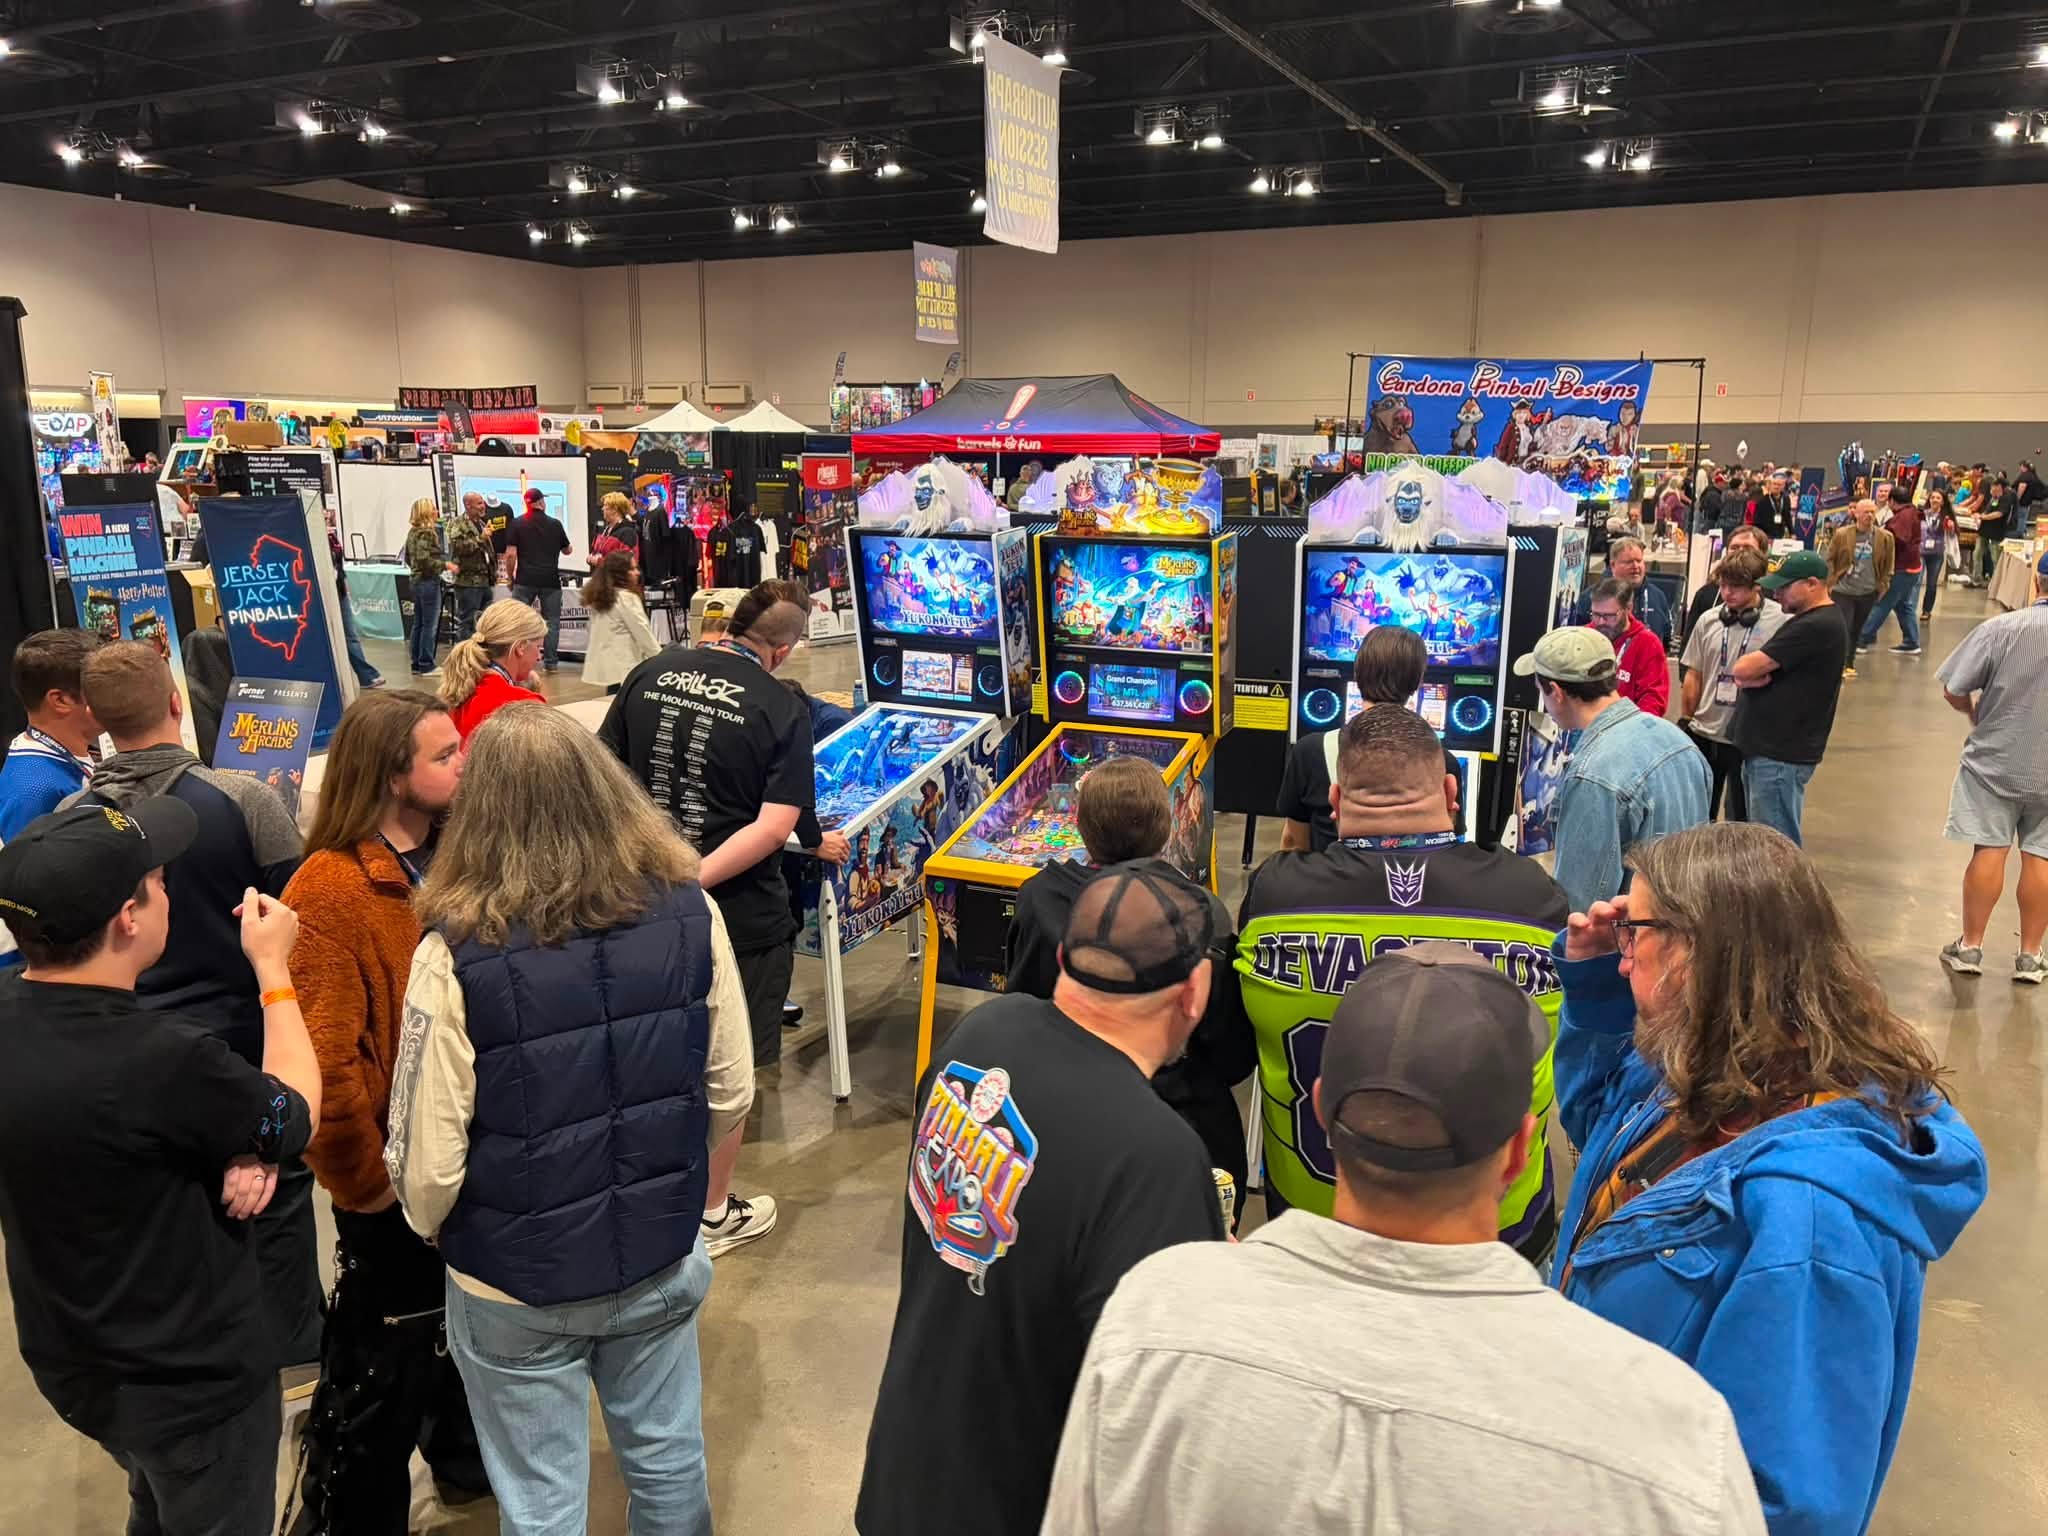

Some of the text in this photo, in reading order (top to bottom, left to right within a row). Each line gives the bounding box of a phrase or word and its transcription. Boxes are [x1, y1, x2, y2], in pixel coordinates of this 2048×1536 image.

[1379, 361, 1638, 404] Cardona Pinball Designs
[956, 436, 1001, 449] barrels
[1018, 438, 1042, 451] fun
[1366, 453, 1386, 473] NO
[59, 514, 130, 536] WIN A NEW
[65, 535, 134, 557] PINBALL
[69, 553, 138, 575] MACHINE
[222, 562, 289, 588] JERSEY
[118, 583, 166, 602] Harry Potter
[235, 585, 289, 610] JACK
[228, 604, 299, 625] PINBALL
[901, 611, 944, 627] YUKON
[656, 671, 745, 708] GORILLAZ
[1106, 675, 1158, 686] Grand Champion
[238, 686, 266, 696] Turner
[273, 689, 309, 699] PRESENTS
[643, 691, 745, 725] THE MOUNTAIN TOUR
[229, 712, 300, 738] MERLIN'S
[238, 735, 294, 754] ARCADE
[927, 1081, 1028, 1240] PINBALL
